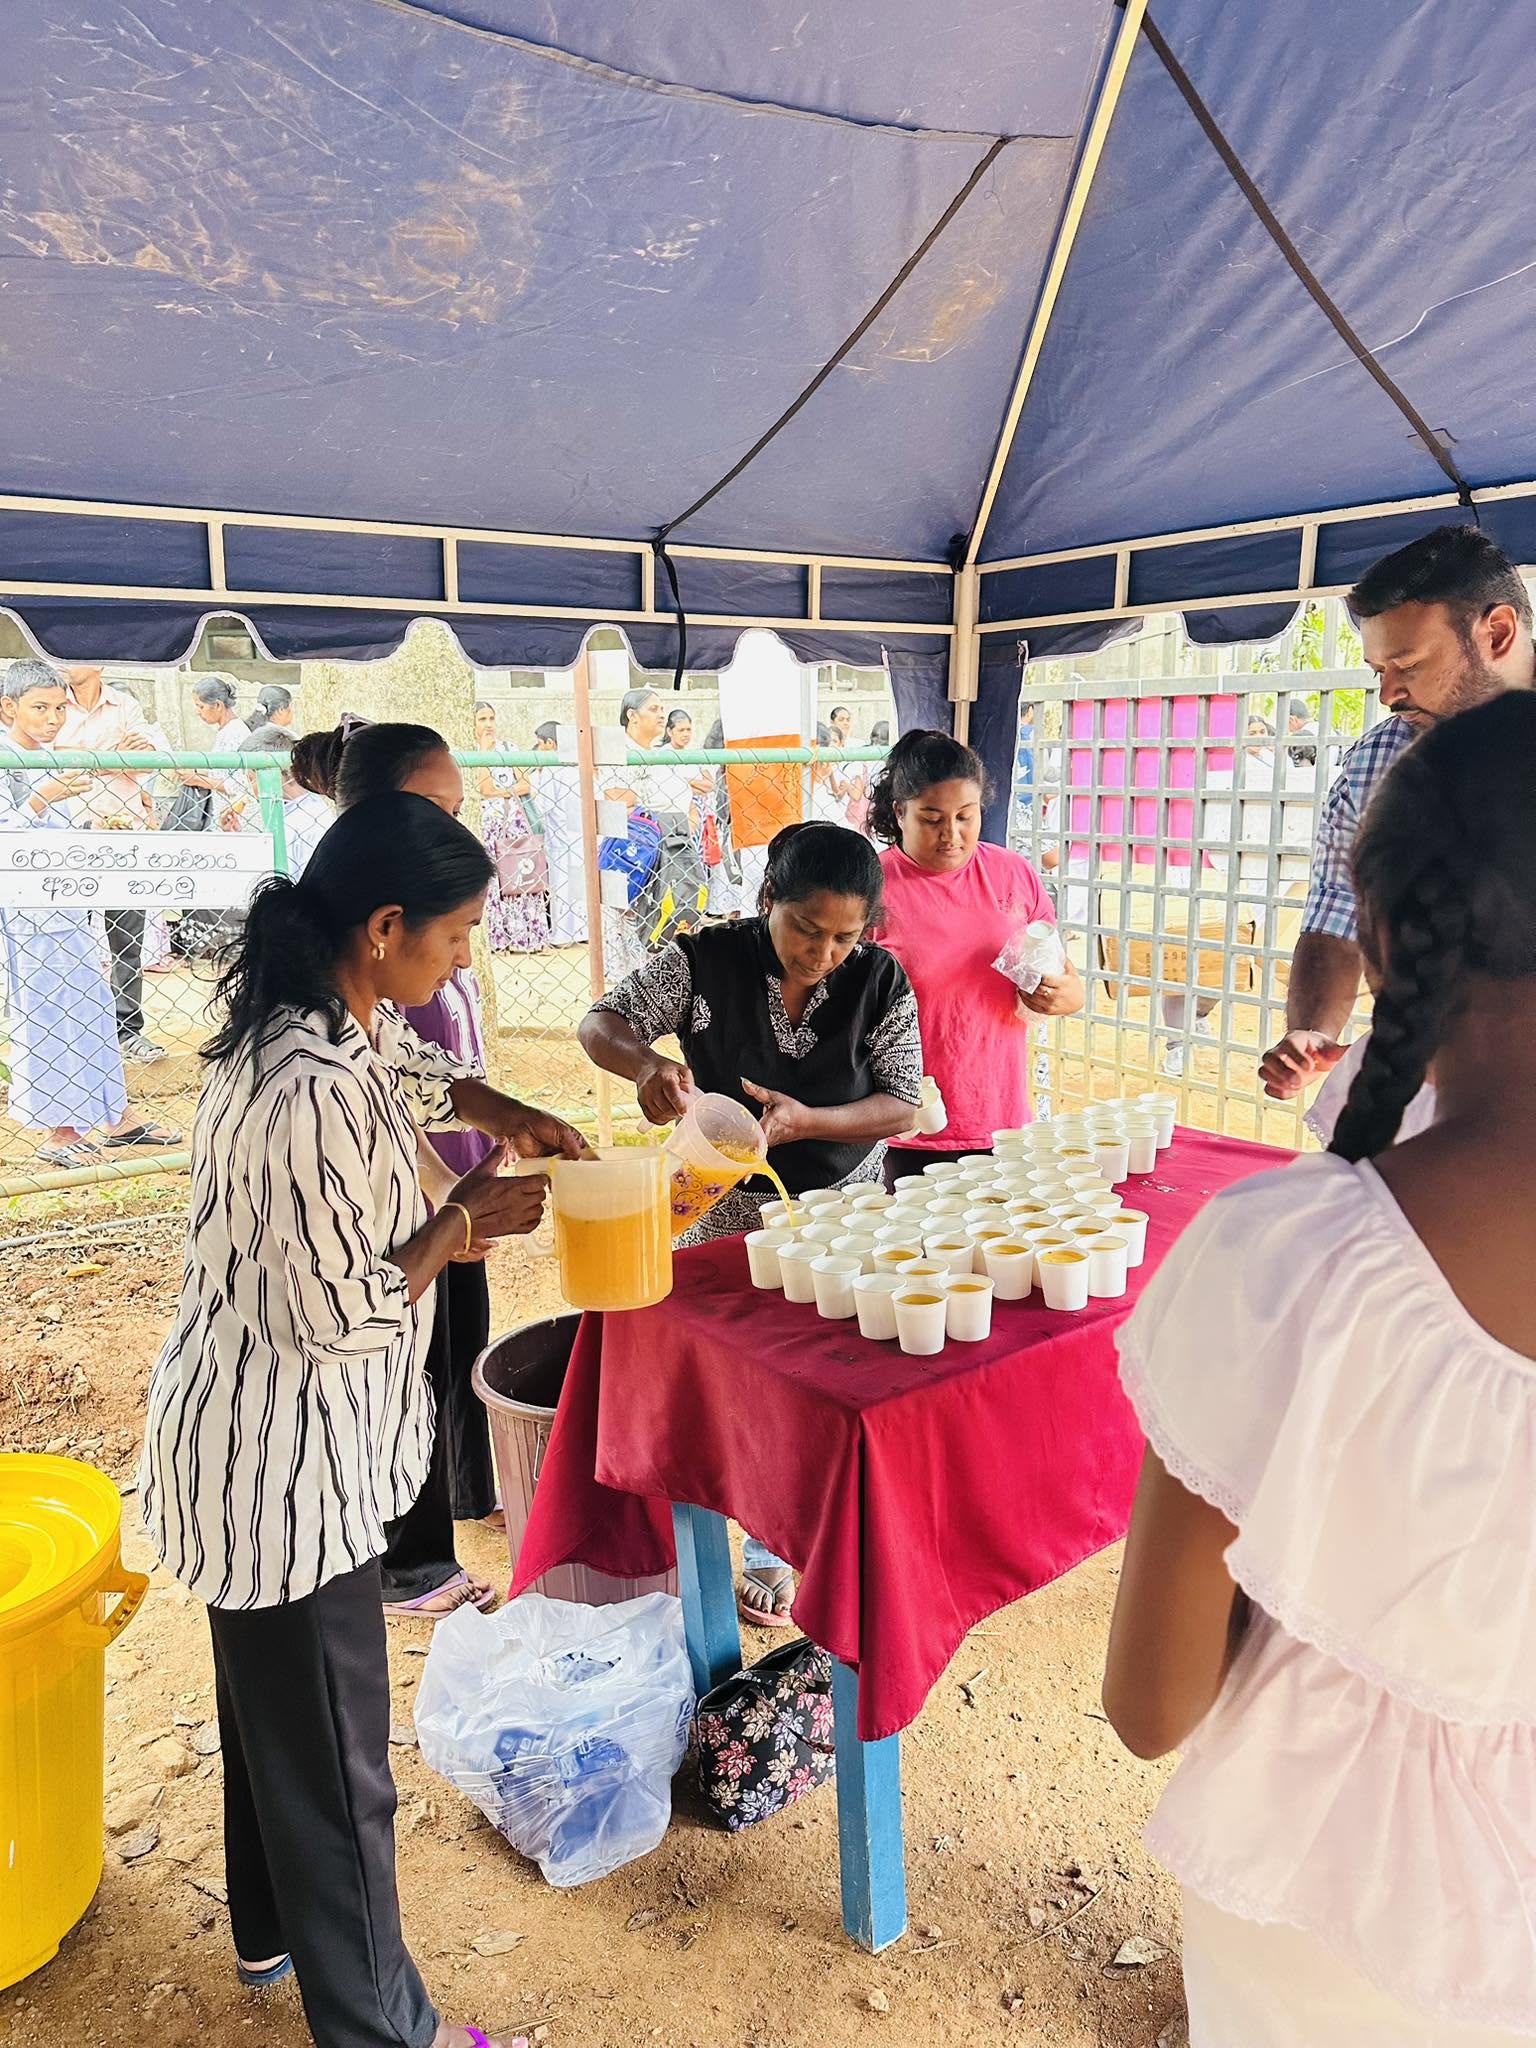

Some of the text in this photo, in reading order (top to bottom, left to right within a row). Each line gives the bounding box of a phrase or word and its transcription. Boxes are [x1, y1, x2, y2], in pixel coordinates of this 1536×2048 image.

[11, 844, 238, 870] පොලිතීන් භාවිතය
[41, 875, 196, 901] අවම කරමු
